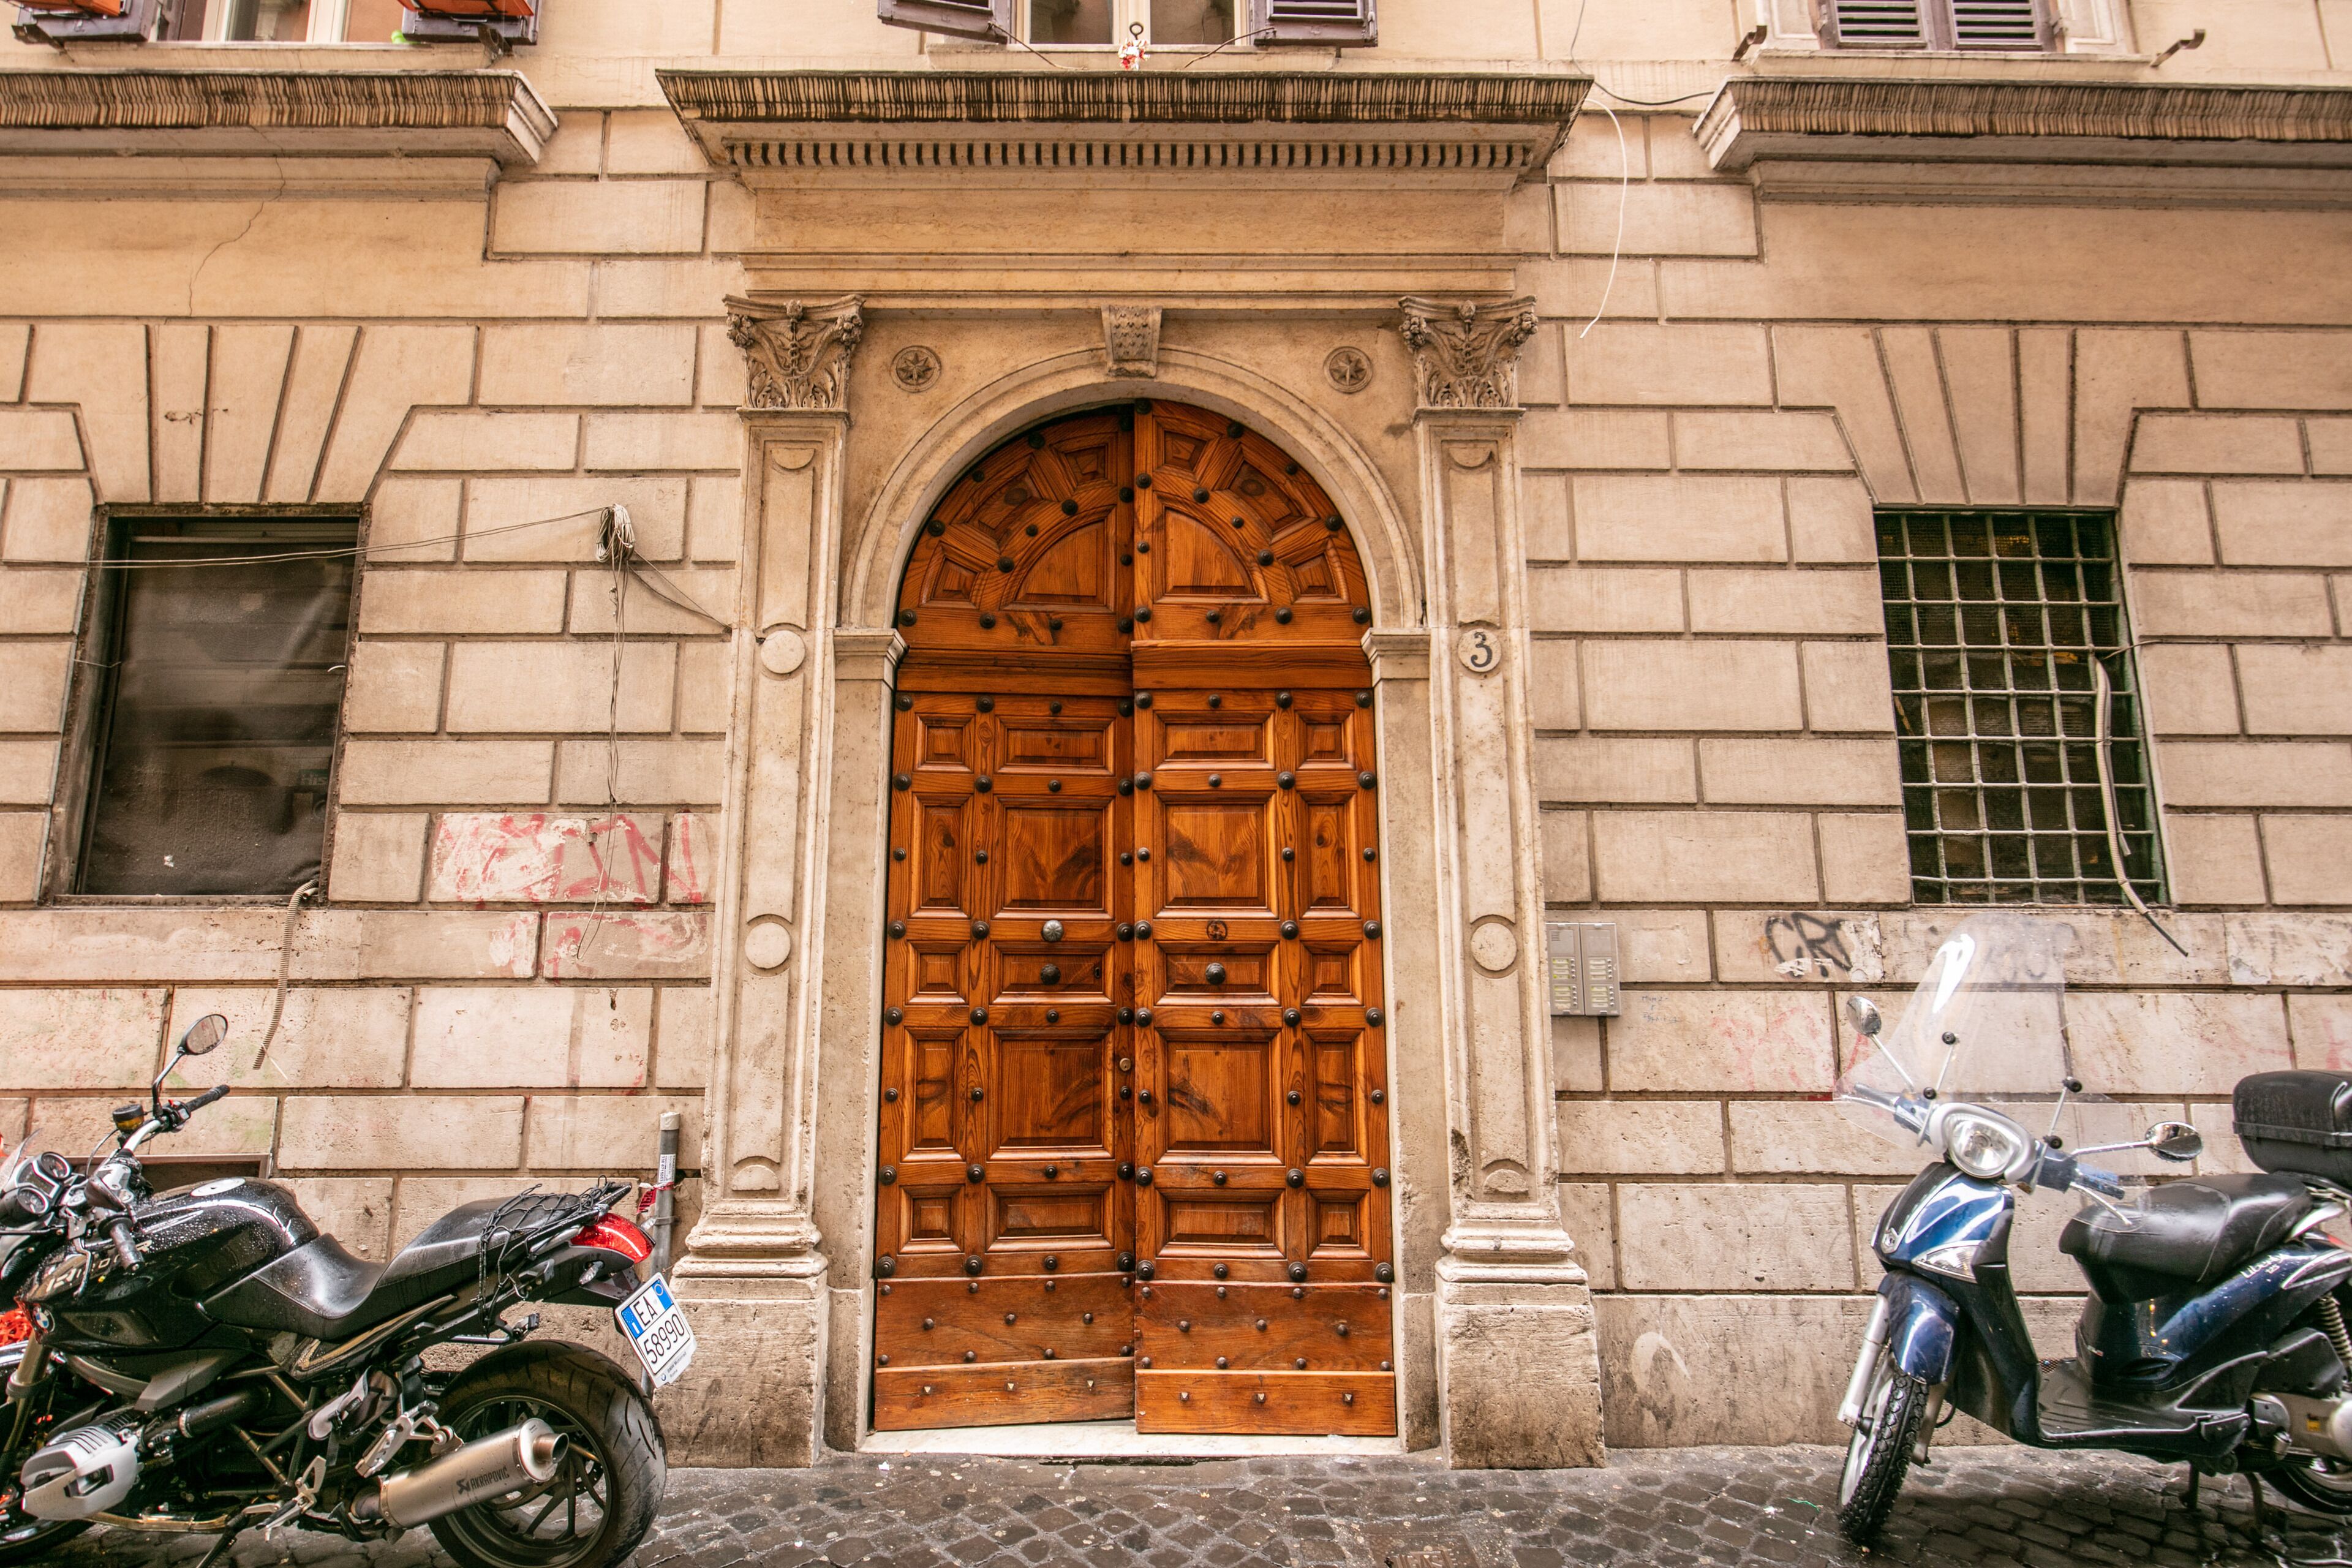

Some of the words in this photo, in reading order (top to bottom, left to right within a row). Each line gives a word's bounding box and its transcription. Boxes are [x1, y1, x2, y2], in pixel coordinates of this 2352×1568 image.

[1471, 632, 1493, 668] 3
[633, 1296, 658, 1327] EA
[643, 1314, 685, 1364] 58990
